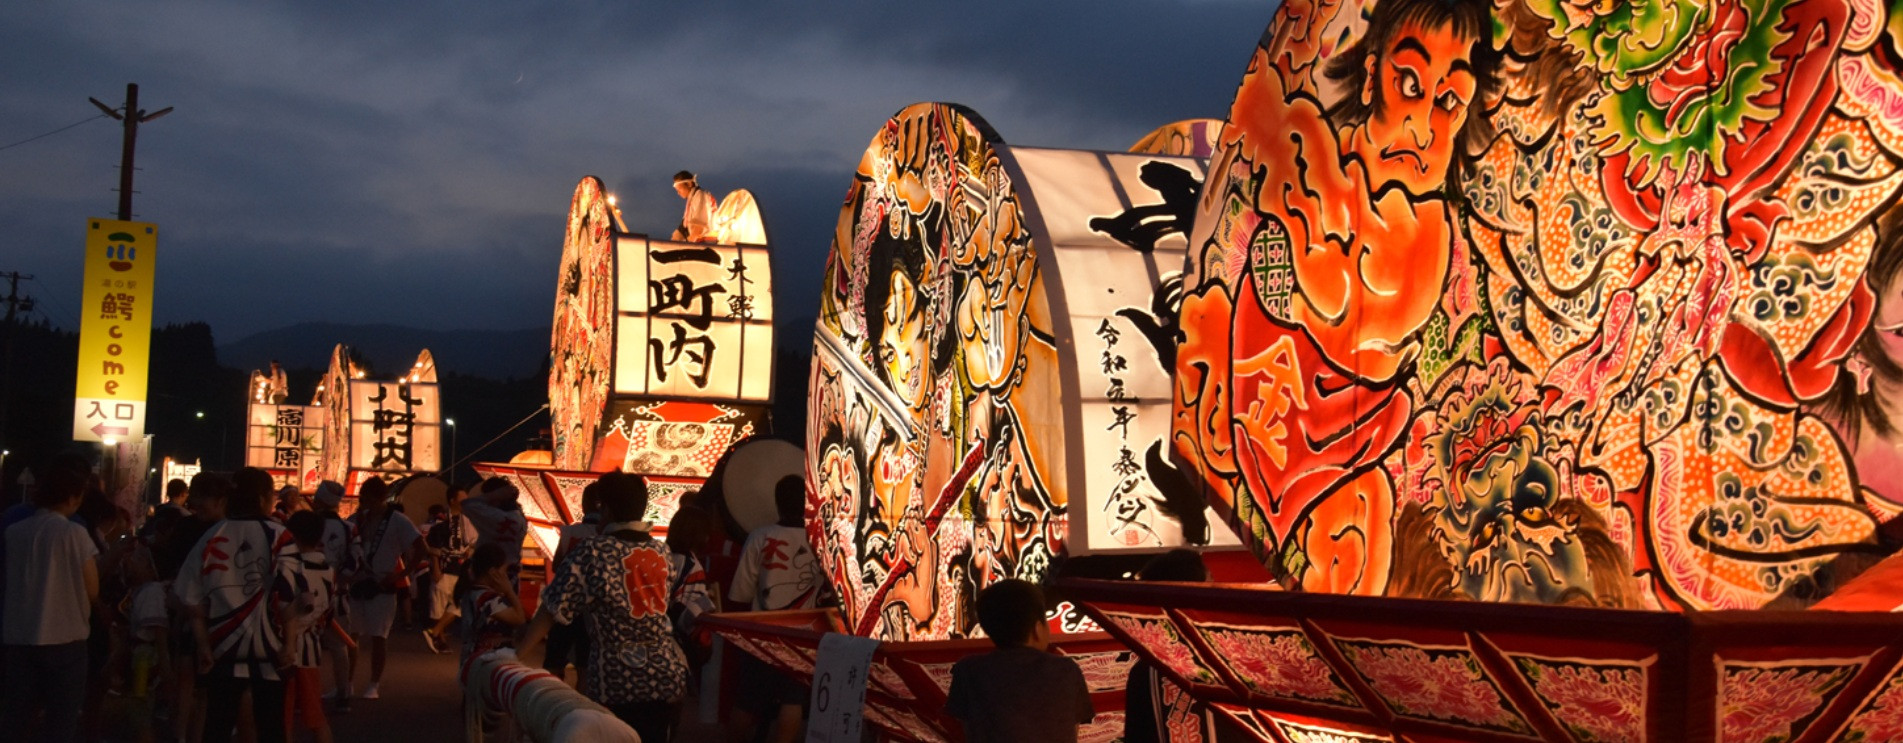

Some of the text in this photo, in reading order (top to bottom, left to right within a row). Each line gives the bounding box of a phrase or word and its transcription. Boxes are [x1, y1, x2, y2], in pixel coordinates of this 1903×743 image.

[649, 247, 727, 389] 一町内
[86, 401, 134, 421] 入口
[275, 408, 304, 467] 宿川原
